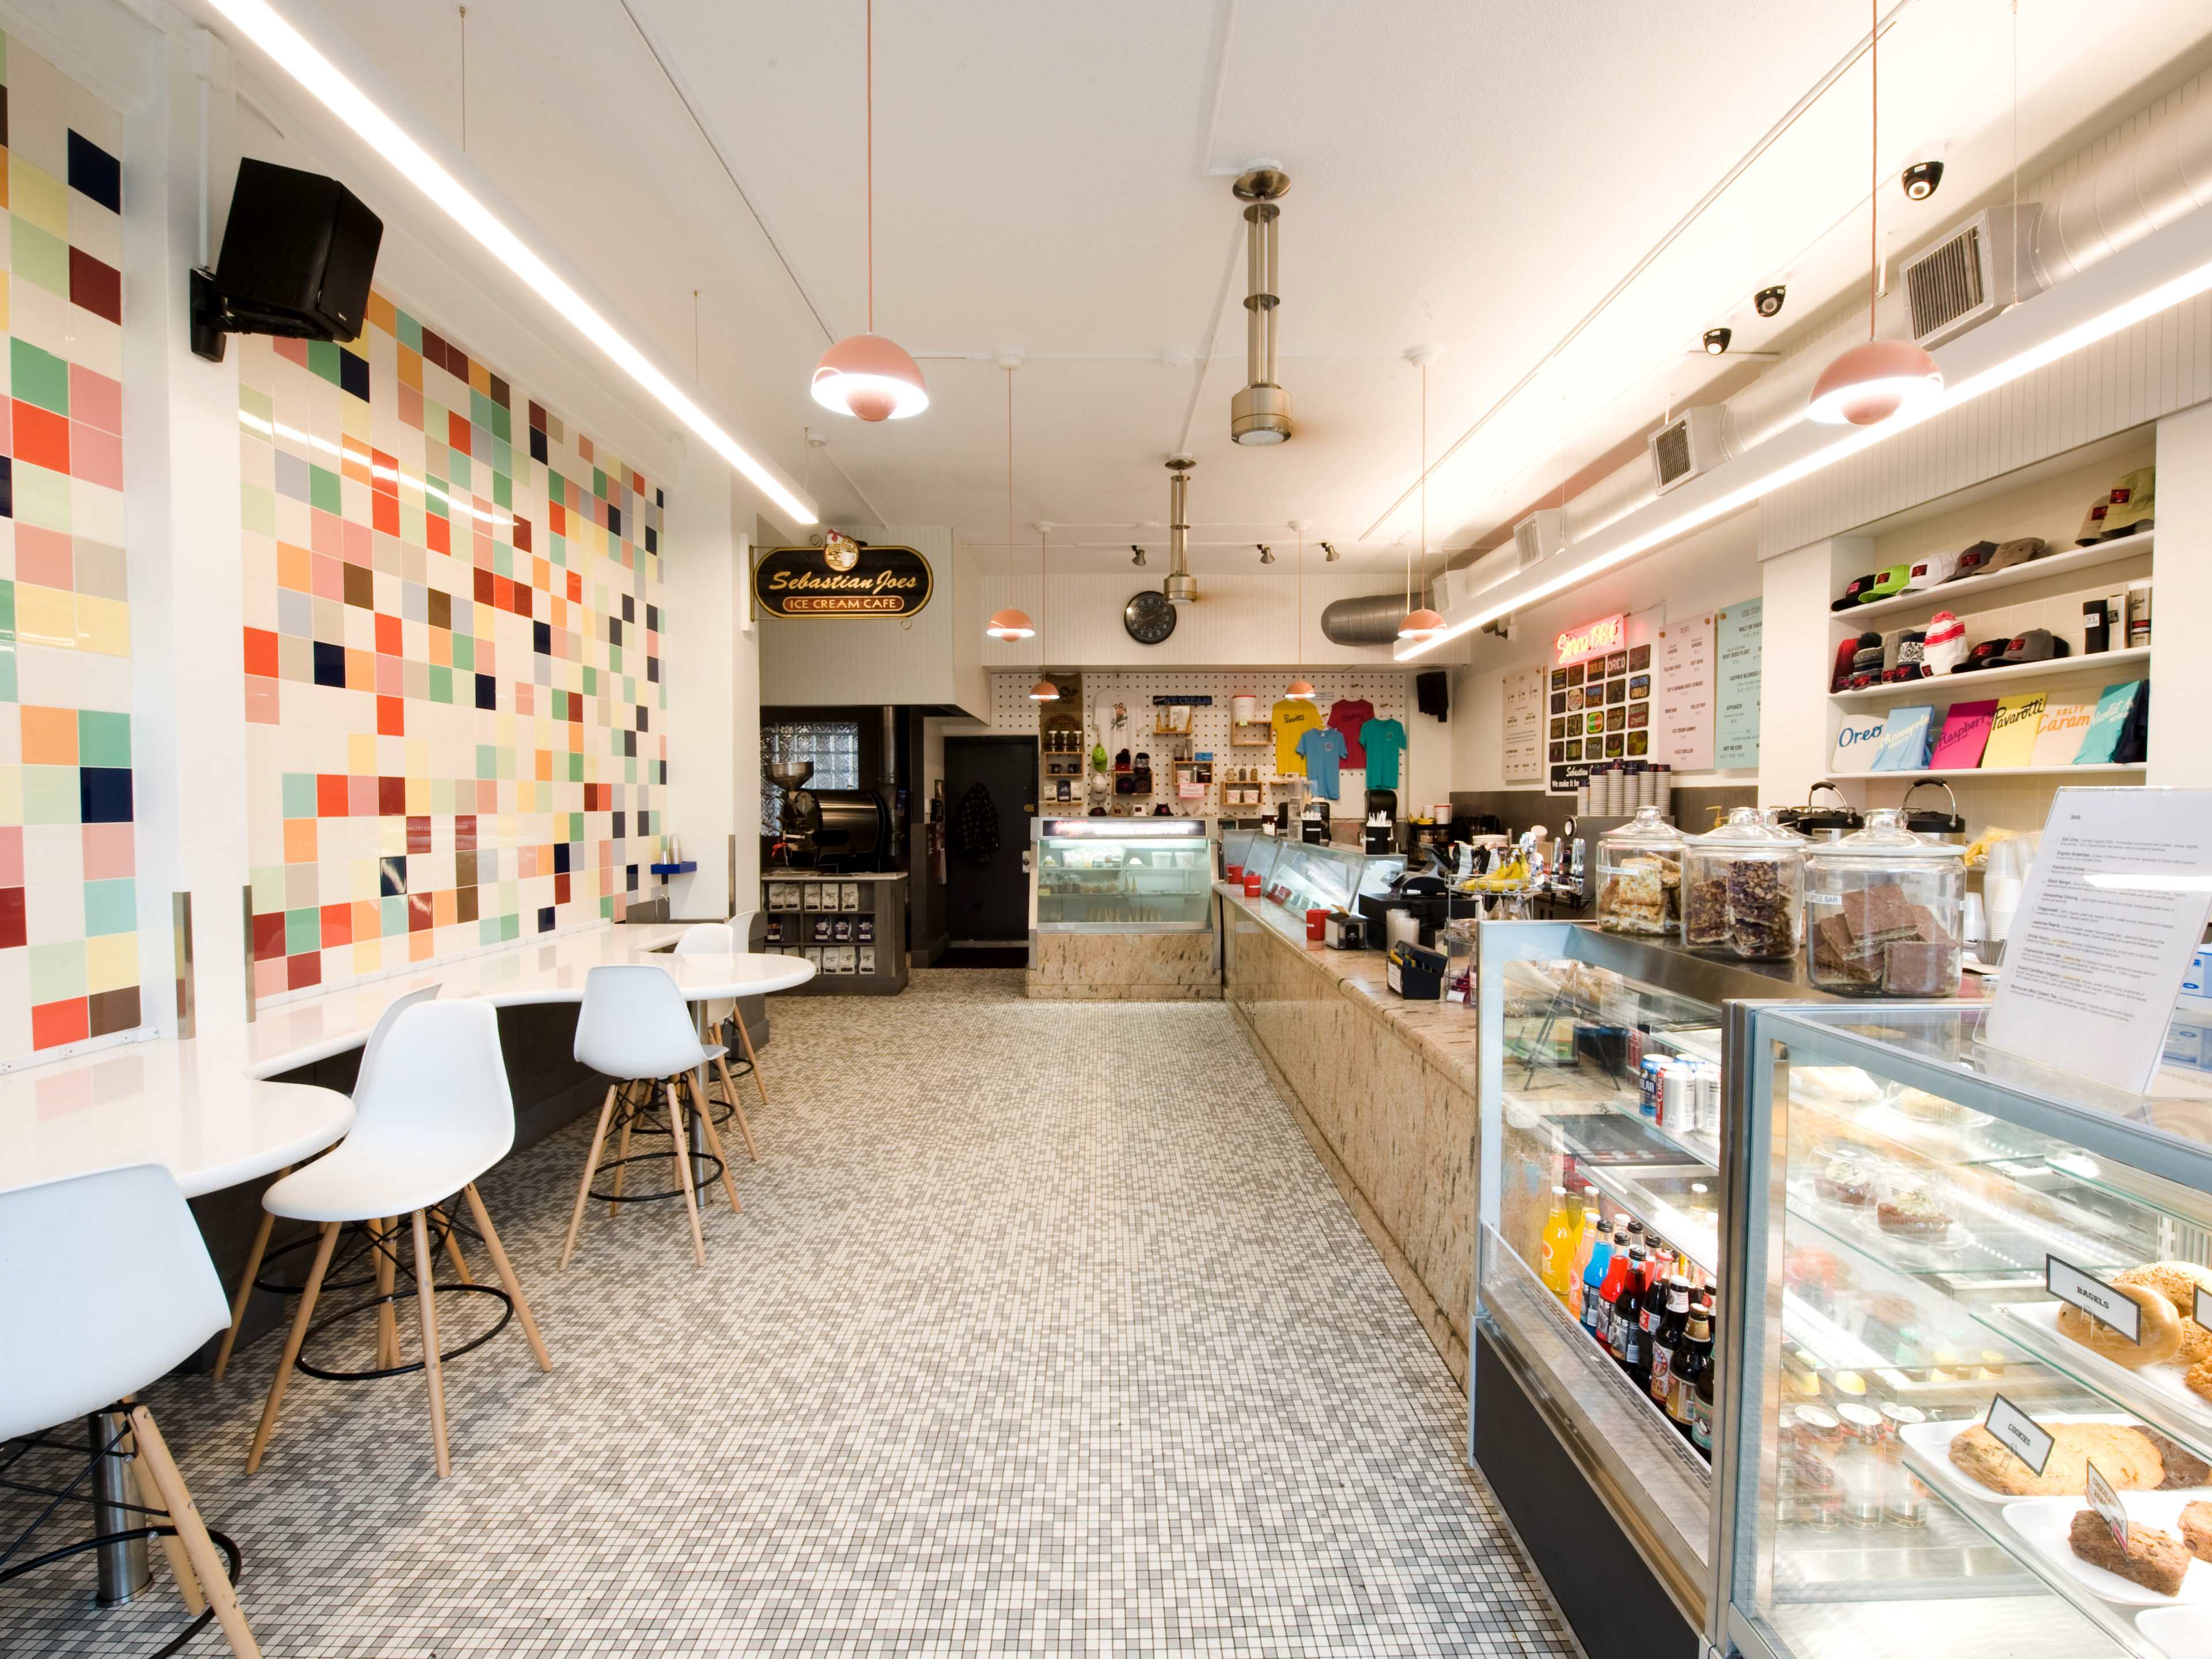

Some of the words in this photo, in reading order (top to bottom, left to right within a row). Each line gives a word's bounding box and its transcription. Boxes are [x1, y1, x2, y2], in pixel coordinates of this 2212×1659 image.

[769, 571, 873, 589] Sebastian
[872, 570, 917, 594] Joes
[790, 599, 808, 609] ICE
[813, 599, 860, 609] CREAM
[864, 599, 896, 608] CAFE
[1608, 658, 1626, 672] OREO
[1993, 698, 2044, 730] Pavarotti
[2056, 705, 2085, 716] SALTY
[2037, 713, 2090, 733] Caram
[1839, 724, 1884, 747] Oreo
[1566, 765, 1588, 777] Sebastian
[1552, 780, 1558, 788] We
[1559, 779, 1569, 787] make
[2077, 1286, 2109, 1309] BAGELS
[2008, 1423, 2031, 1446] COOKIES
